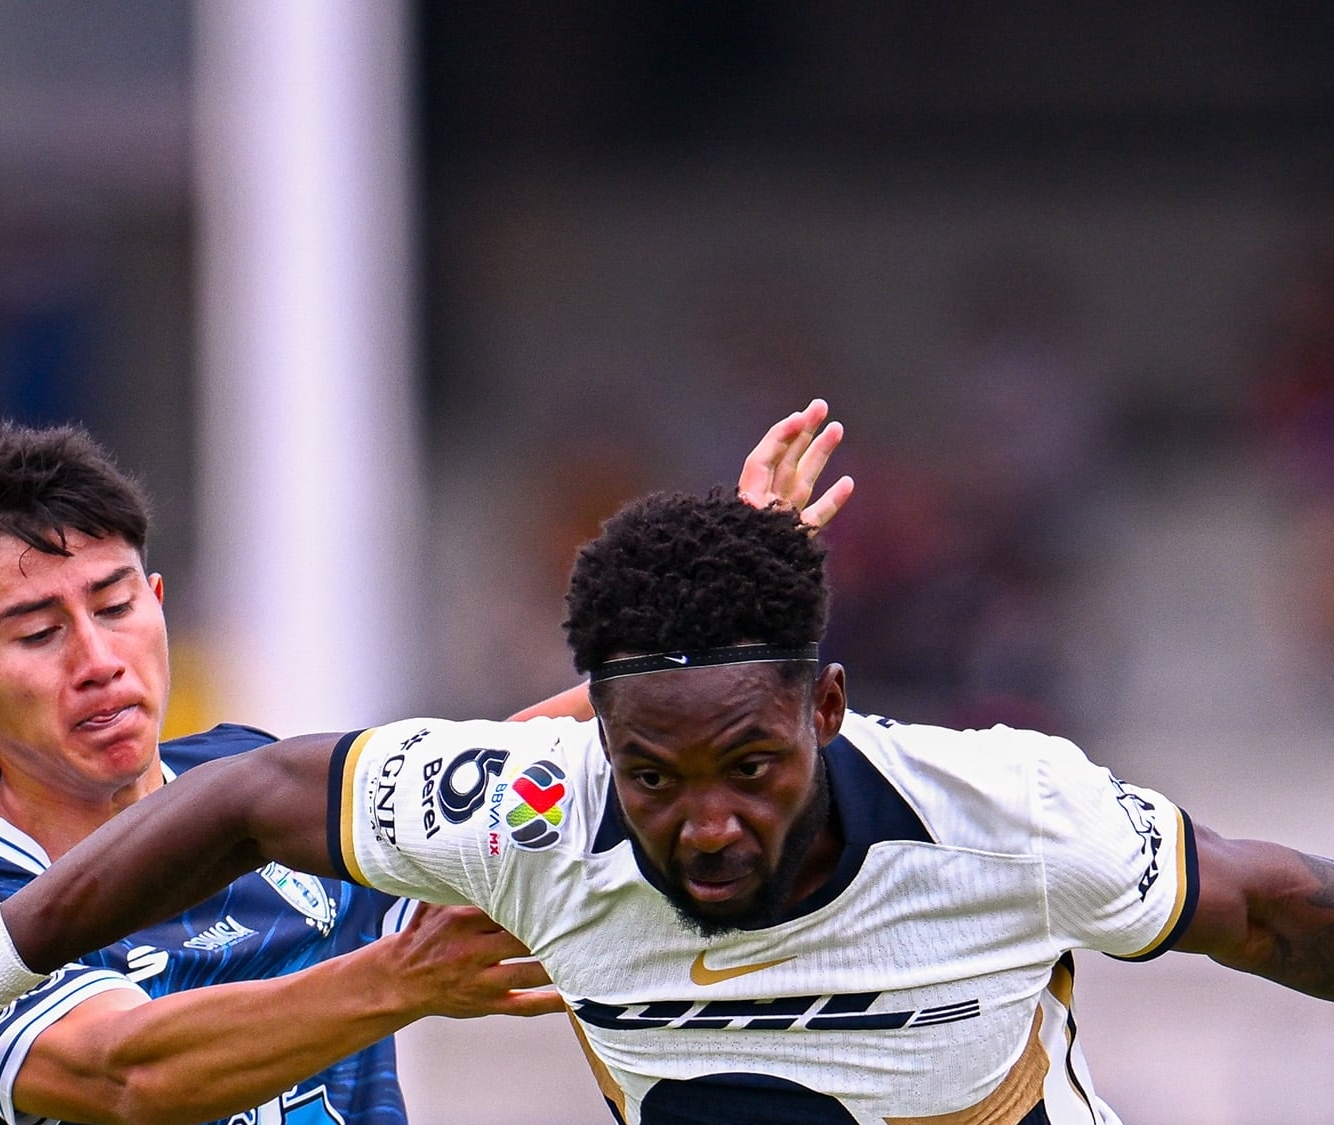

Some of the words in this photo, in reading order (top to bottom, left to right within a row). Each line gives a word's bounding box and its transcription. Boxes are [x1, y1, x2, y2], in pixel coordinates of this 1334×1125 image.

[377, 754, 405, 846] GNP
[423, 757, 443, 840] Berel
[489, 783, 508, 828] BBVA
[489, 833, 500, 856] MX
